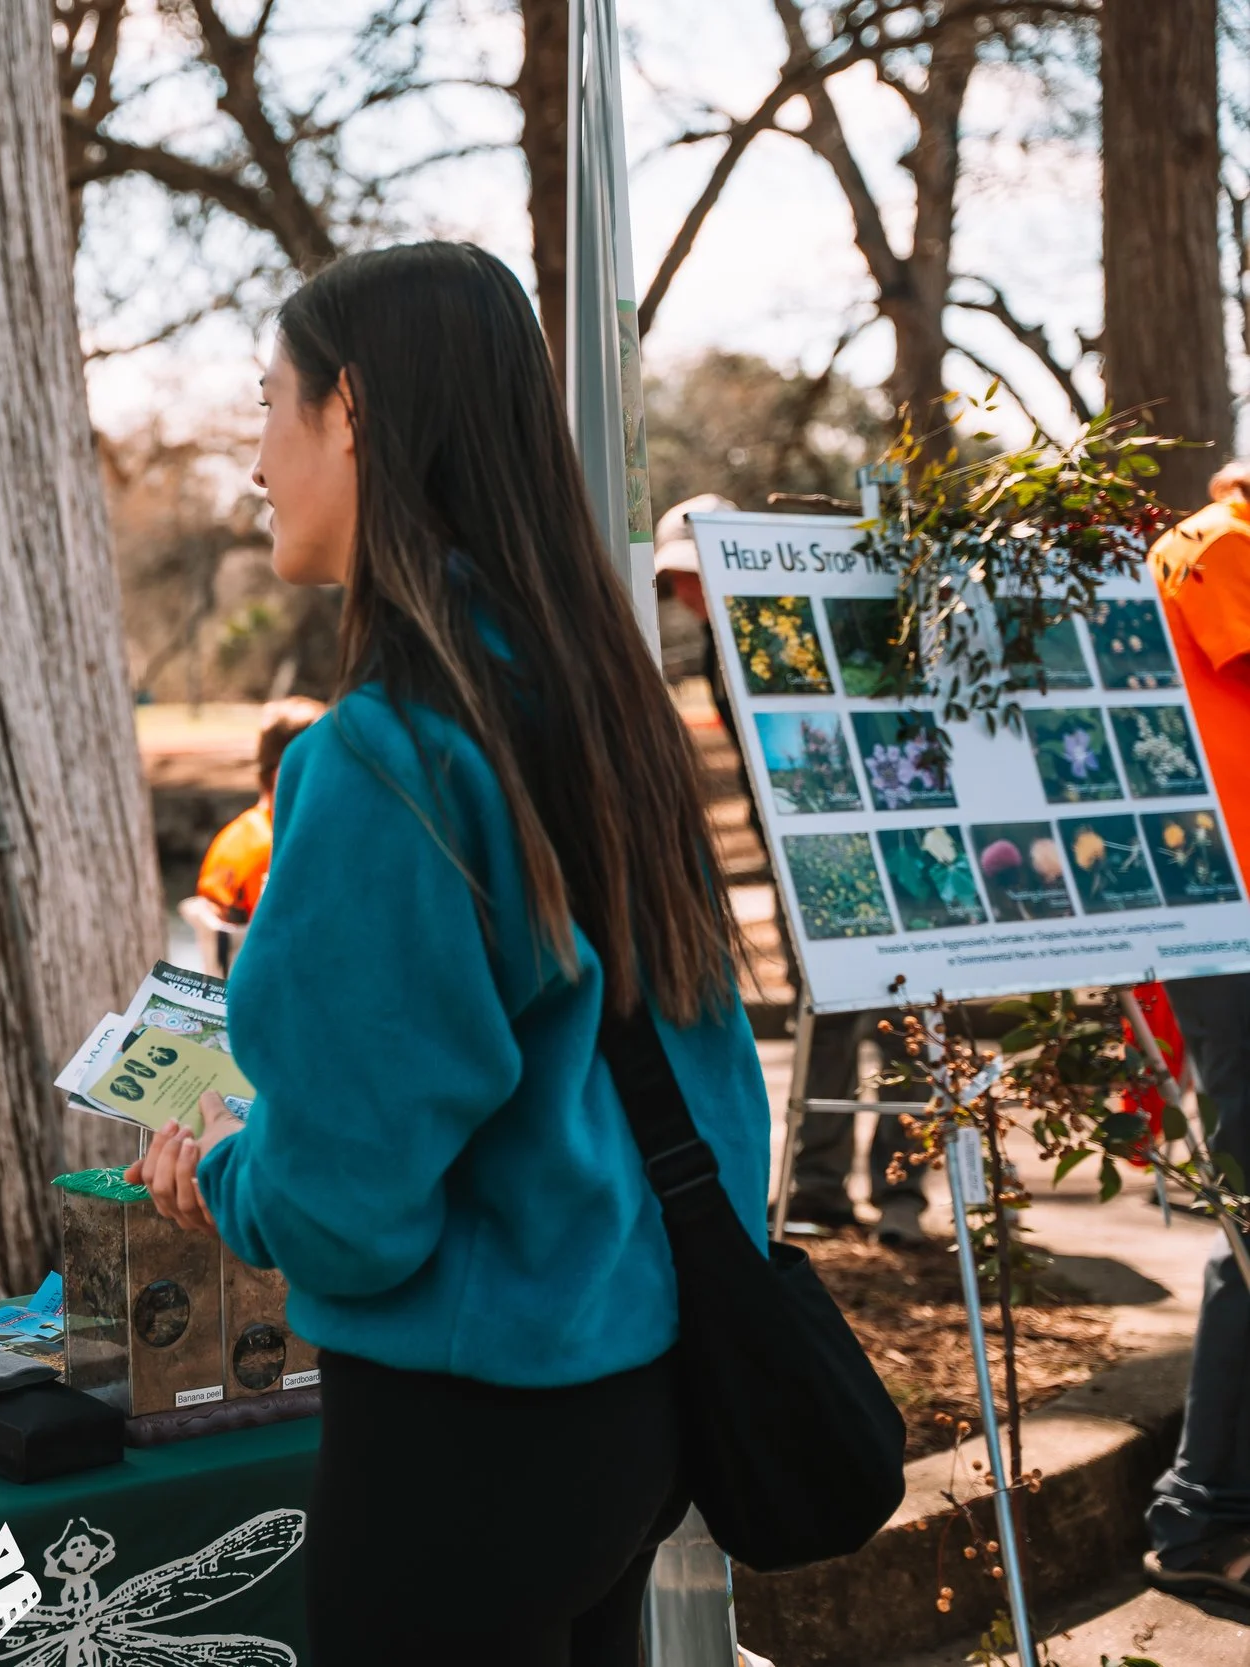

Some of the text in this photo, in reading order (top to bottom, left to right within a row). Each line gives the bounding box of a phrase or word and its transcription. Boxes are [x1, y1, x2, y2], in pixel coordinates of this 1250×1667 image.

[162, 971, 202, 988] RECREATION
[284, 1373, 320, 1387] Cardboard
[178, 1389, 222, 1404] Banana peel
